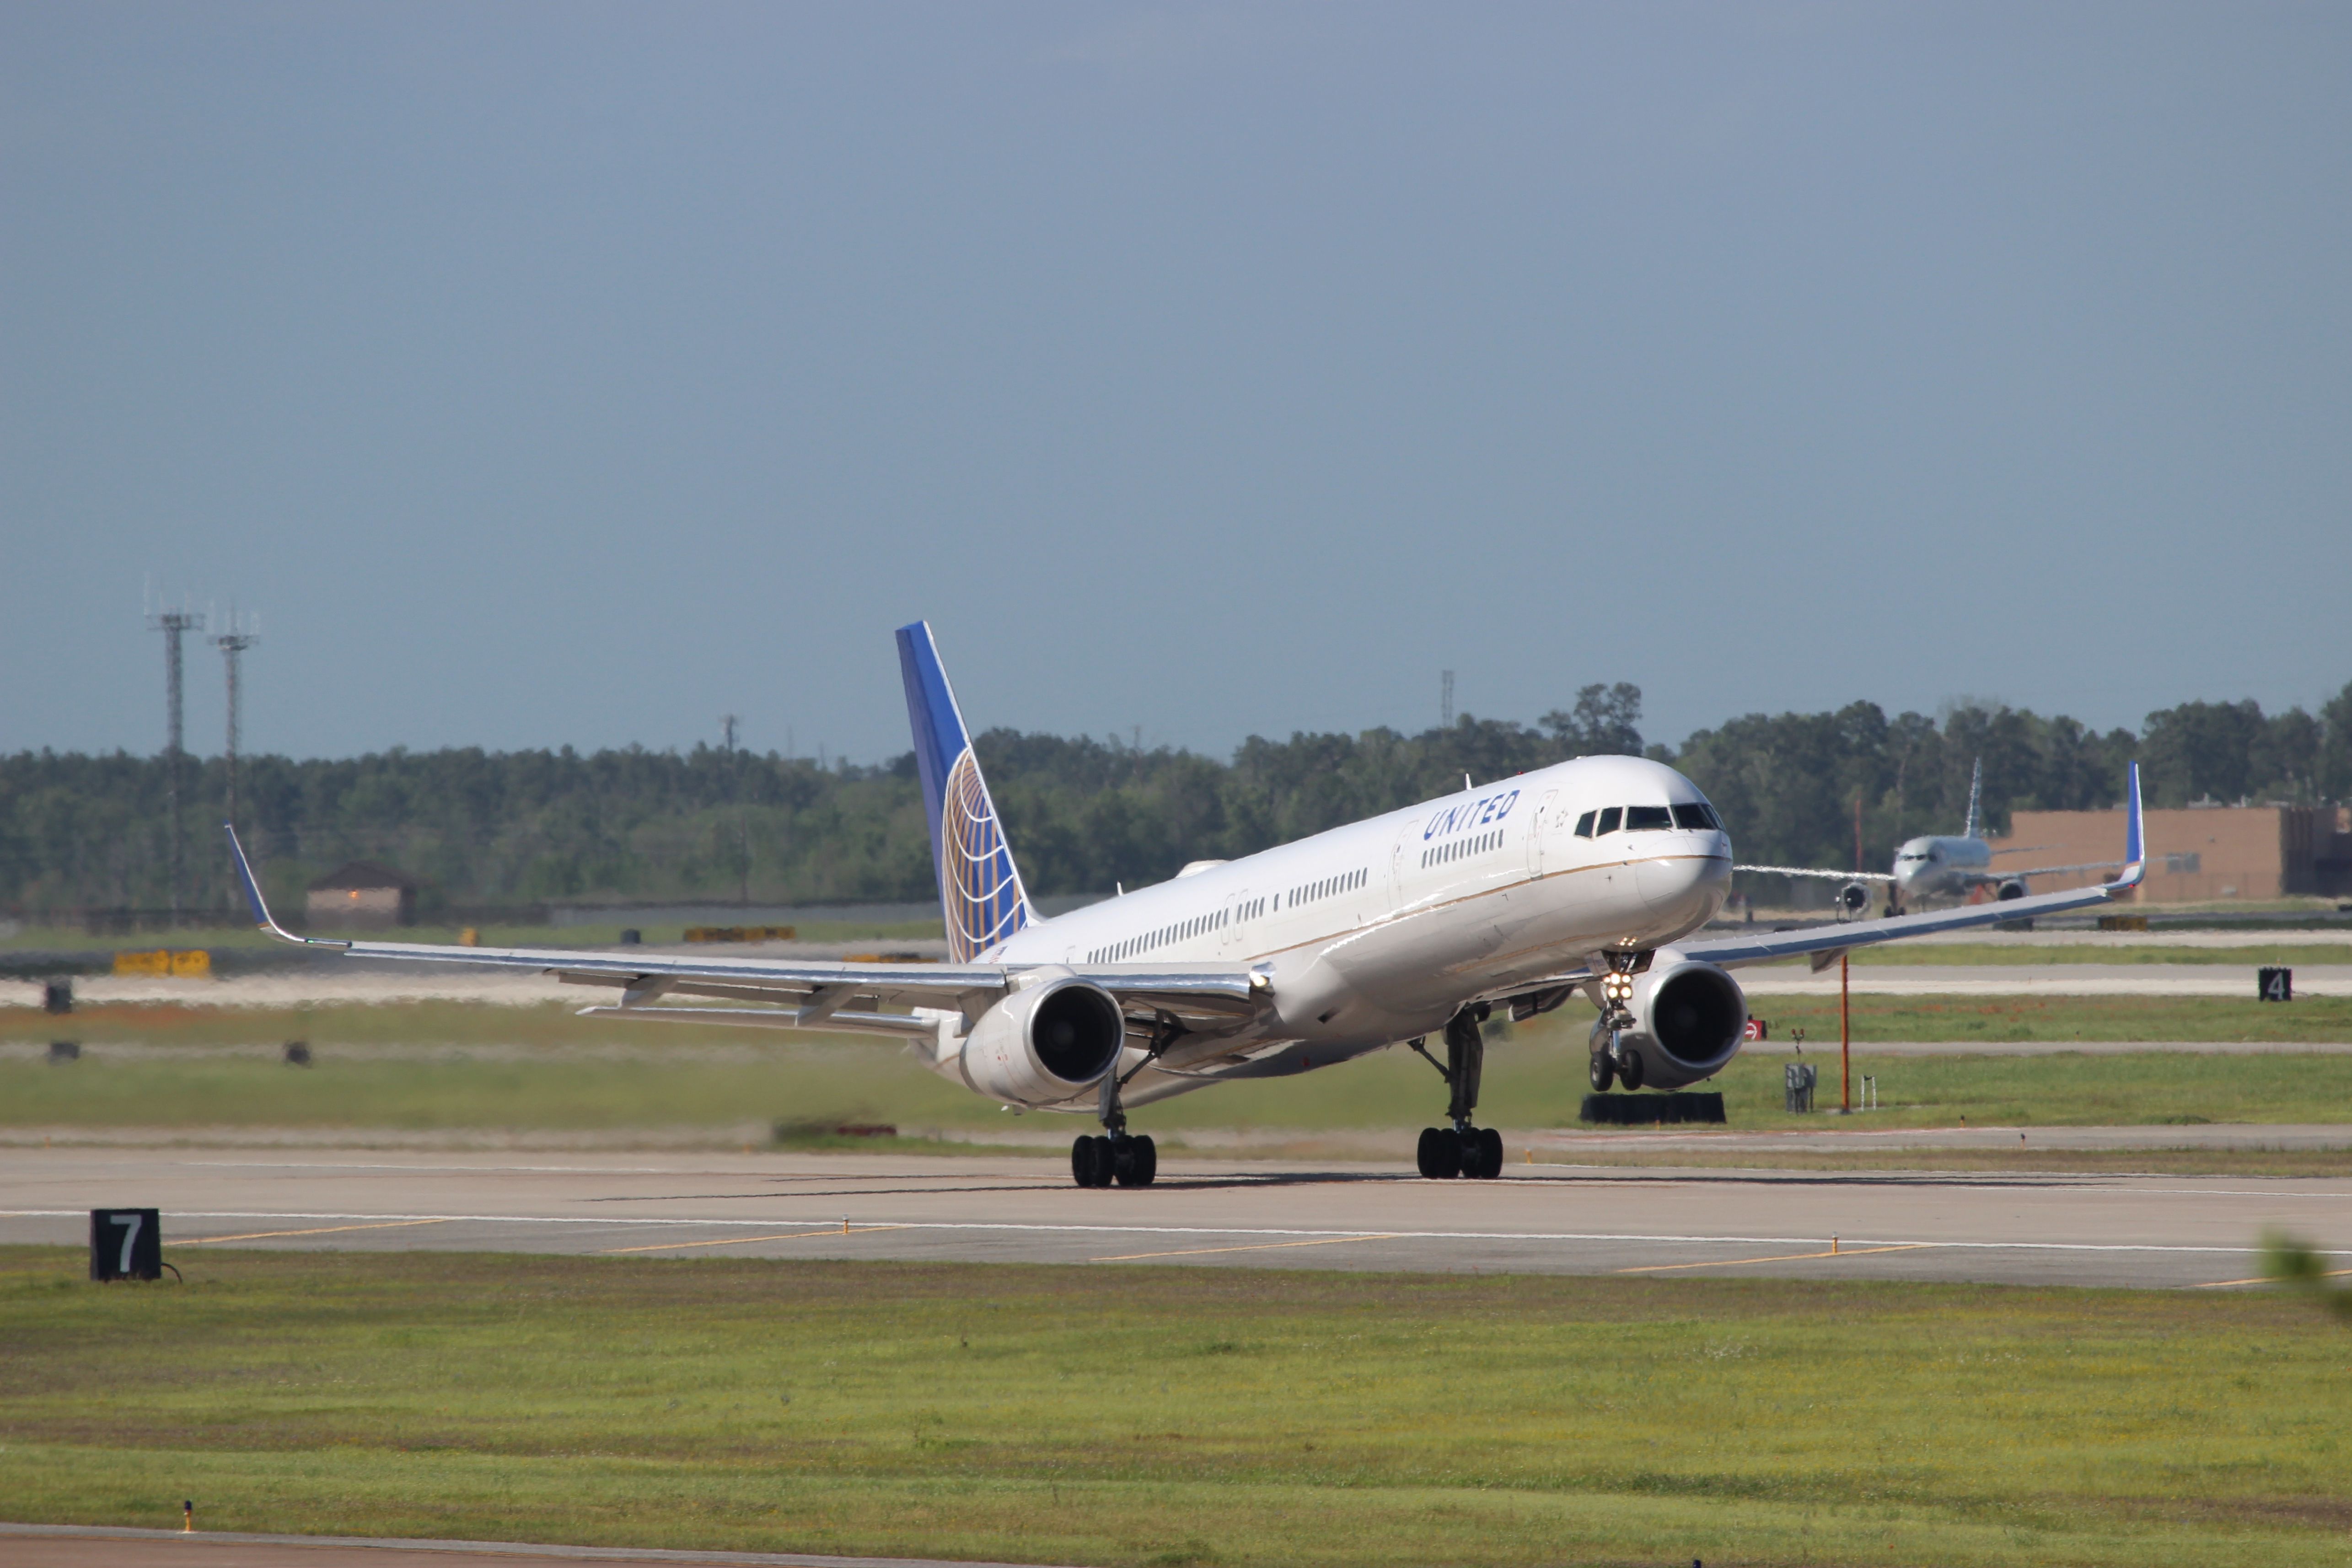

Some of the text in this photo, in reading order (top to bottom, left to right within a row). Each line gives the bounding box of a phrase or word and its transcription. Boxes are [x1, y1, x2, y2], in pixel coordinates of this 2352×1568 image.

[1424, 789, 1520, 841] UNITED
[2268, 972, 2284, 999] 4
[110, 1215, 142, 1273] 7
